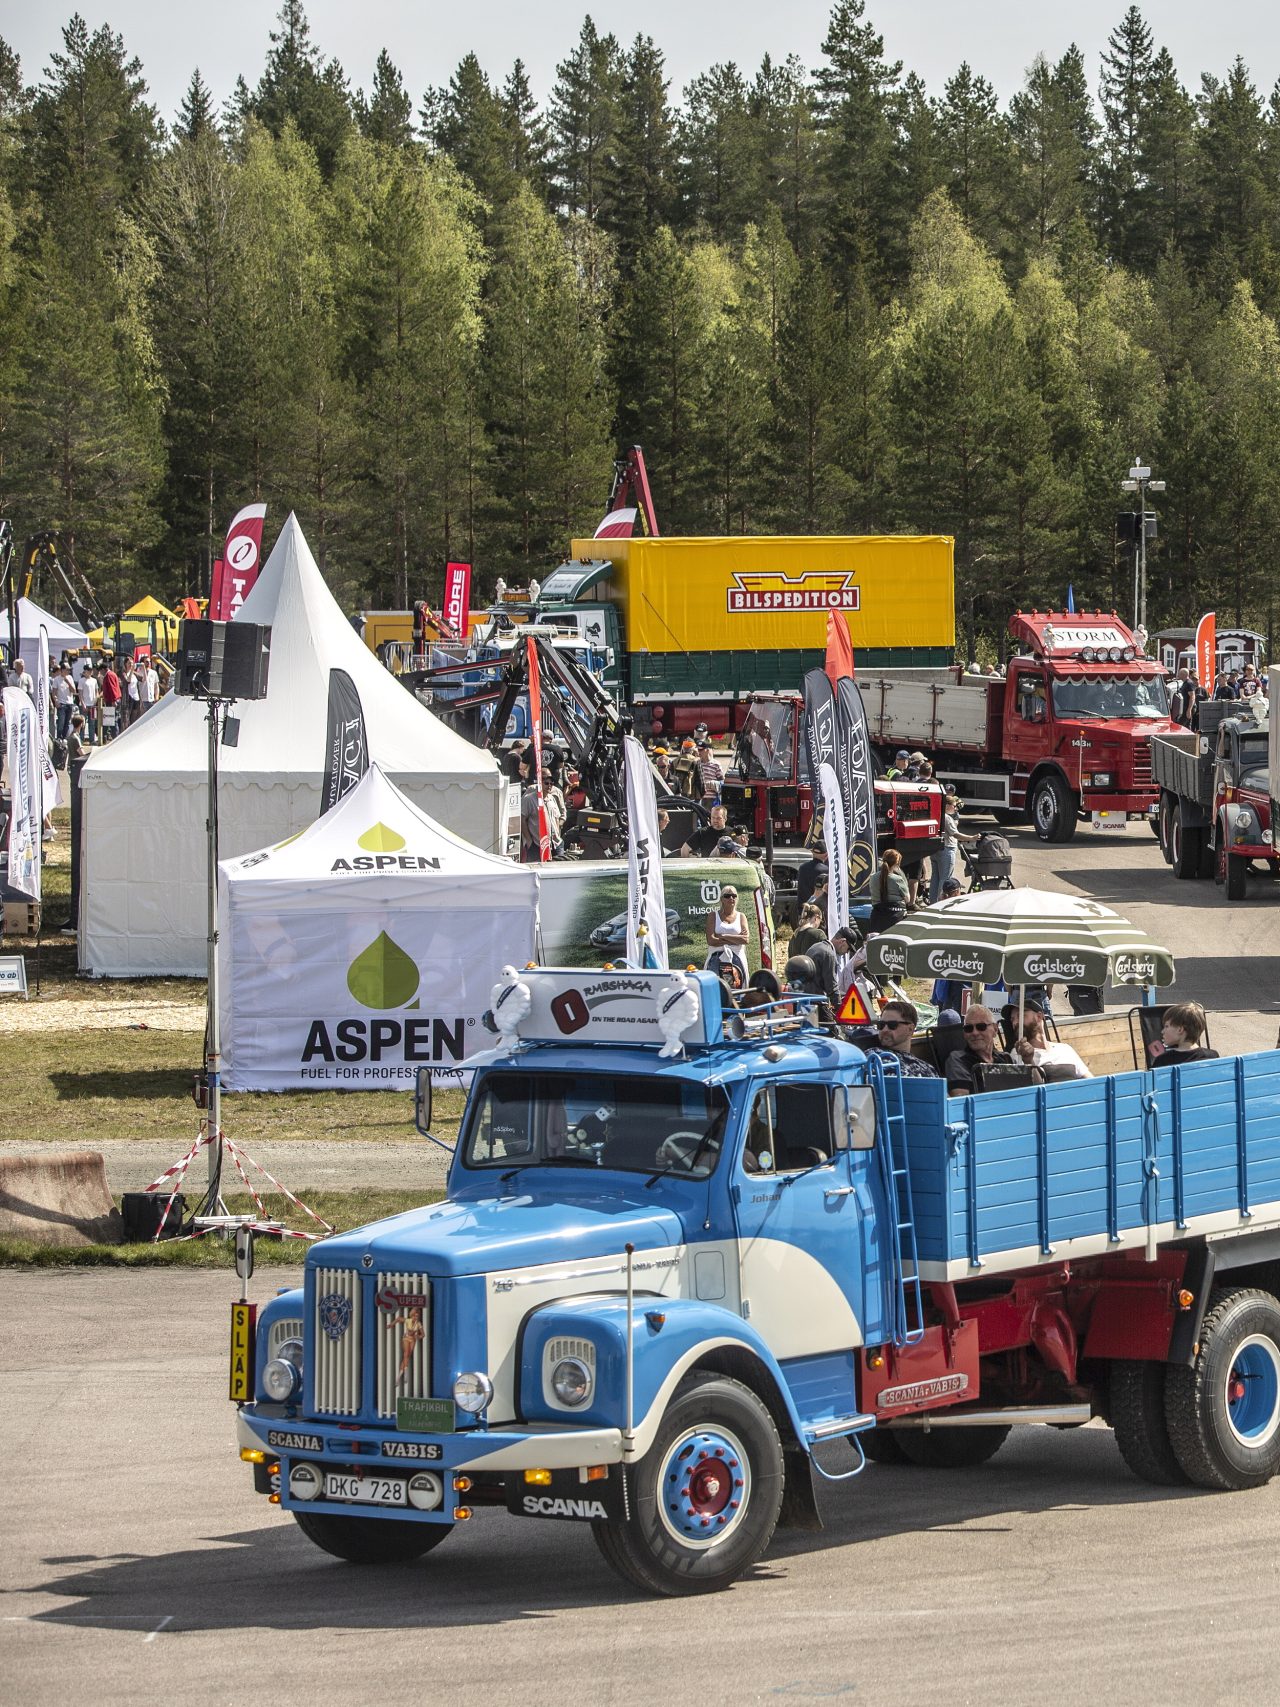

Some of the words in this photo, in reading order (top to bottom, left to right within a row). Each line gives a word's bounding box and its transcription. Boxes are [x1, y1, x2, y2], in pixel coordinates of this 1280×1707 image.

[735, 591, 853, 608] BILSPEDITION
[1055, 630, 1120, 642] STORM
[928, 949, 985, 975] Carlsberg
[1023, 954, 1087, 980] Carlsberg
[1115, 955, 1156, 980] Carlsberg
[592, 1016, 602, 1024] ON
[603, 1016, 615, 1024] THE
[636, 1017, 659, 1025] AGAIN
[301, 1067, 332, 1079] FUEL
[336, 1067, 360, 1079] FOR
[363, 1066, 464, 1079] PROFESSNALS
[750, 1192, 782, 1204] Johan
[379, 1285, 425, 1314] SUPER
[235, 1309, 245, 1395] SLÄP
[403, 1400, 449, 1413] TRAFIKBIL
[269, 1431, 321, 1451] SCANIA
[384, 1442, 441, 1459] VABIS
[329, 1475, 360, 1498] DKG
[370, 1480, 402, 1501] 728
[522, 1495, 608, 1519] SCANIA
